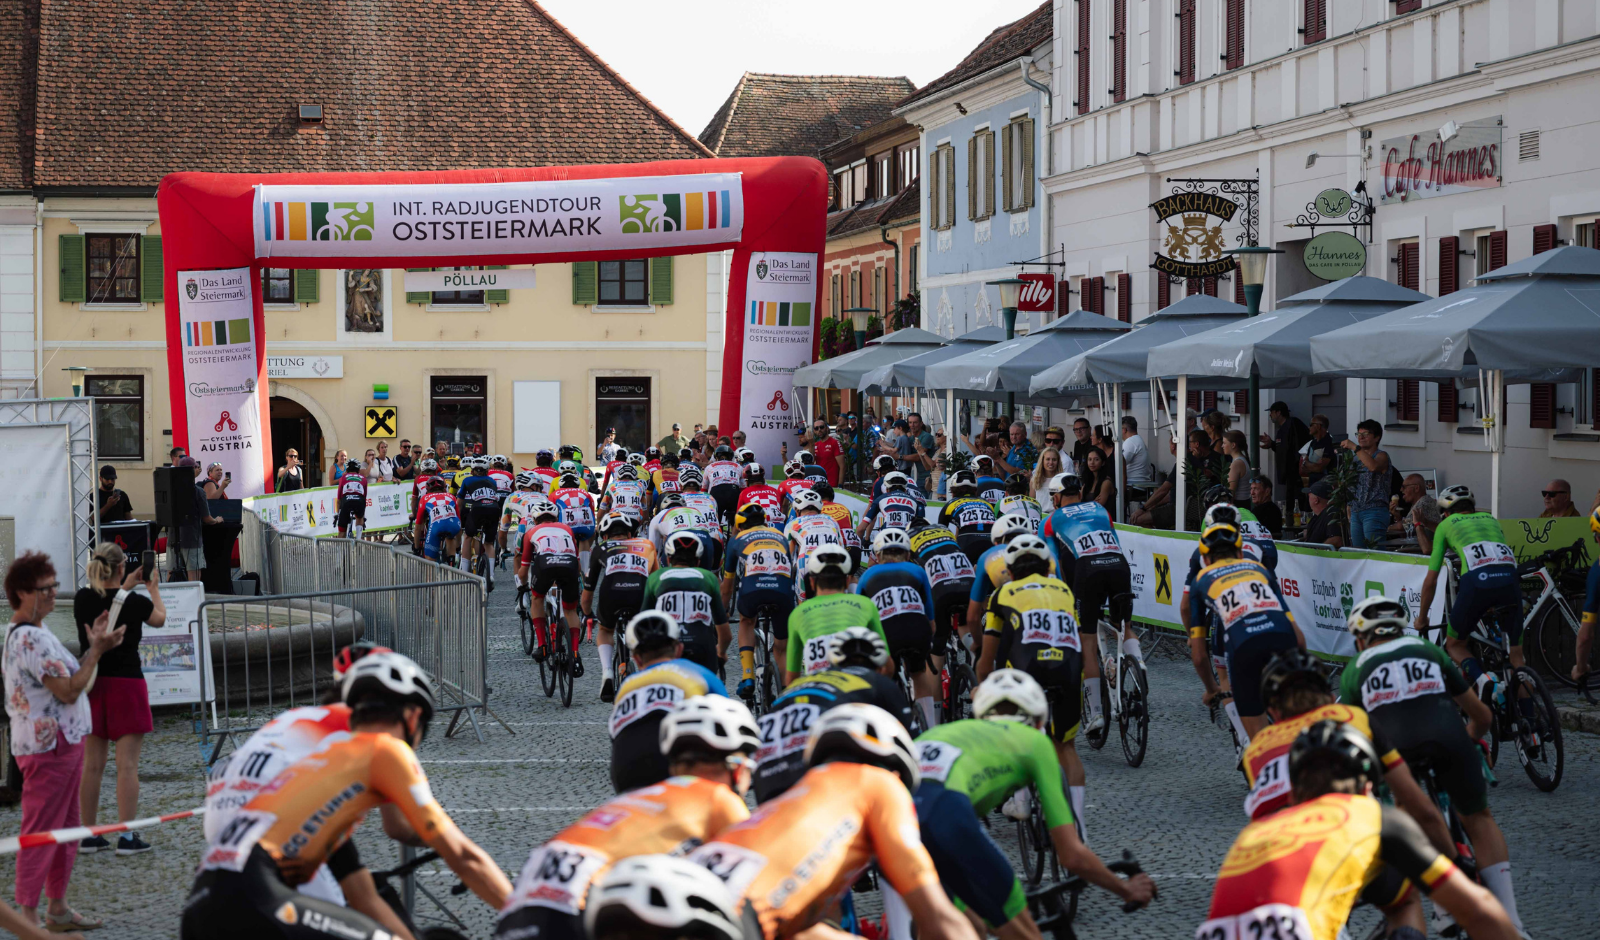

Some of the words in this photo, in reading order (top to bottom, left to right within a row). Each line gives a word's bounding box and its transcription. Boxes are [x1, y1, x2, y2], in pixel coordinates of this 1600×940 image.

[1384, 135, 1421, 201] Cafe
[1425, 141, 1497, 189] Hannes
[393, 201, 427, 216] INT.
[432, 196, 602, 216] RADJUGENDTOUR
[1154, 194, 1235, 219] BACKHAUS
[392, 217, 602, 241] OSTSTEIERMARK
[1307, 246, 1362, 261] Hannes
[772, 259, 789, 269] Das
[790, 259, 810, 269] Land
[1156, 258, 1233, 276] GOTTHARDT
[201, 278, 219, 288] Das
[221, 276, 243, 287] Land
[444, 274, 497, 287] PÖLLAU
[769, 272, 810, 283] Steiermark
[200, 288, 244, 300] Steiermark
[1020, 279, 1052, 307] illy
[749, 328, 810, 336] REGIONALENTWICKLUNG
[749, 335, 809, 344] OSTSTEIERMARK
[187, 346, 251, 356] REGIONALENTWICKLUNG
[188, 354, 251, 364] OSTSTEIERMARK
[751, 421, 800, 430] AUSTRIA
[211, 434, 242, 442] CYCLING
[201, 441, 252, 452] AUSTRIA
[886, 498, 913, 507] AVIA
[889, 512, 902, 522] 105
[962, 510, 978, 522] 225
[979, 510, 995, 521] 225
[805, 534, 819, 546] 144
[1078, 534, 1096, 550] 121
[1099, 532, 1116, 545] 121
[752, 551, 765, 565] 96
[773, 551, 787, 565] 96
[1471, 544, 1487, 559] 31
[1497, 544, 1512, 556] 31
[610, 554, 626, 565] 182
[927, 558, 945, 575] 221
[952, 555, 970, 569] 221
[1008, 583, 1070, 596] isorex
[661, 593, 677, 611] 161
[691, 594, 708, 611] 161
[876, 592, 894, 610] 213
[900, 588, 919, 603] 213
[1222, 590, 1240, 612] 92
[1250, 582, 1271, 600] 92
[802, 599, 862, 615] SLOVENIA
[1028, 612, 1050, 630] 136
[809, 640, 826, 660] 35
[1402, 661, 1435, 683] 162
[646, 686, 675, 703] 201
[780, 707, 810, 736] 222
